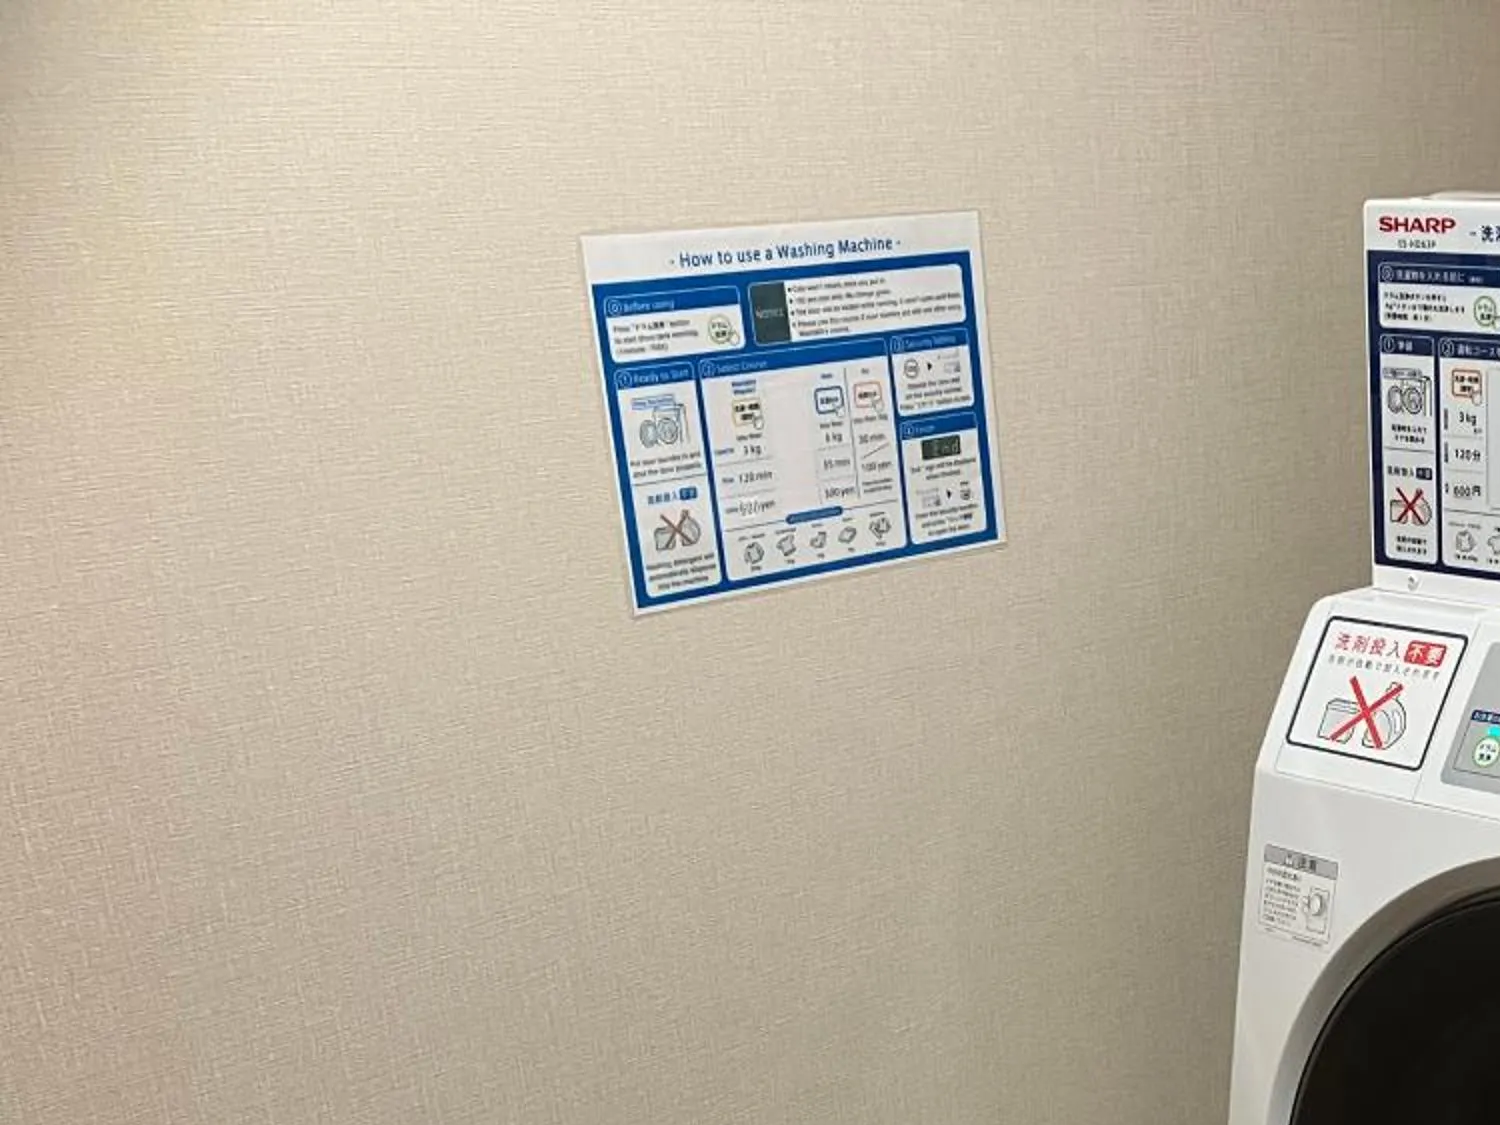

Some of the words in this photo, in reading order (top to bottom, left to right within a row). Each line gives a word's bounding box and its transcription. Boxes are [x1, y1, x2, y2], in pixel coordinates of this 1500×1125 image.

[1378, 215, 1456, 234] SHARP
[680, 252, 713, 268] How
[718, 250, 733, 265] to
[737, 249, 761, 263] use
[765, 248, 774, 260] a
[776, 240, 835, 259] Washing
[837, 236, 893, 253] Machine
[1334, 632, 1400, 658] 洗剤投入
[1407, 643, 1444, 666] 不要
